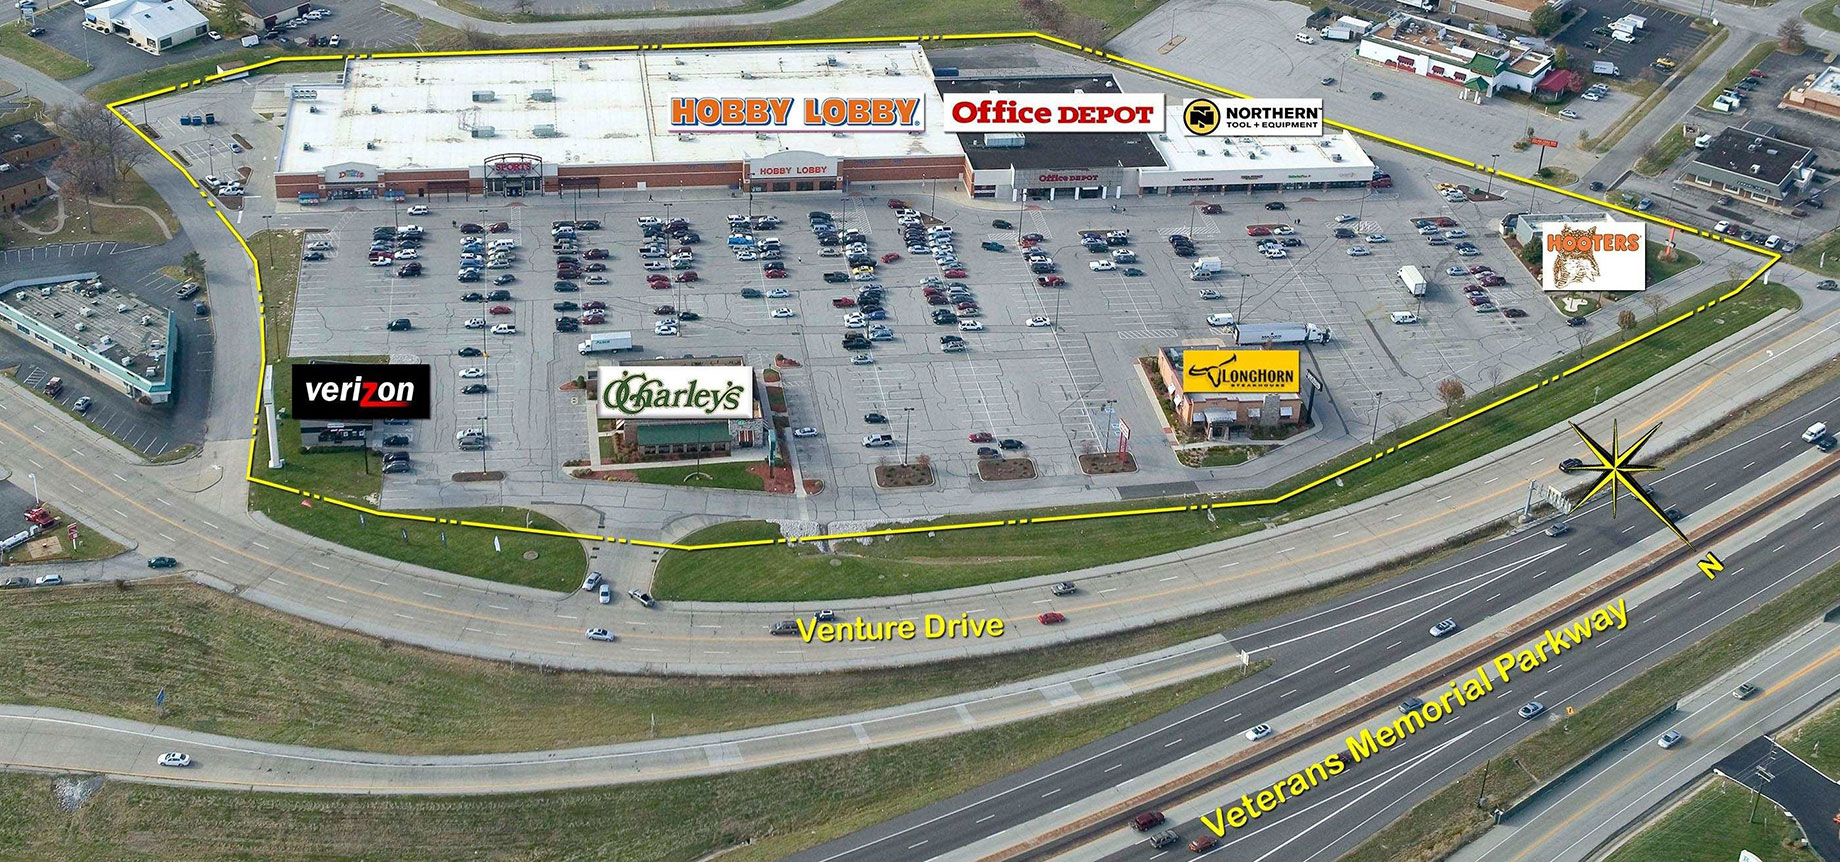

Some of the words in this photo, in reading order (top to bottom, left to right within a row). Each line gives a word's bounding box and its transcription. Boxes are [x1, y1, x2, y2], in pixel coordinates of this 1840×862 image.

[495, 162, 531, 171] SPORTS
[759, 167, 792, 175] HOBBY
[796, 166, 828, 174] LOBBY
[1039, 174, 1068, 182] Office
